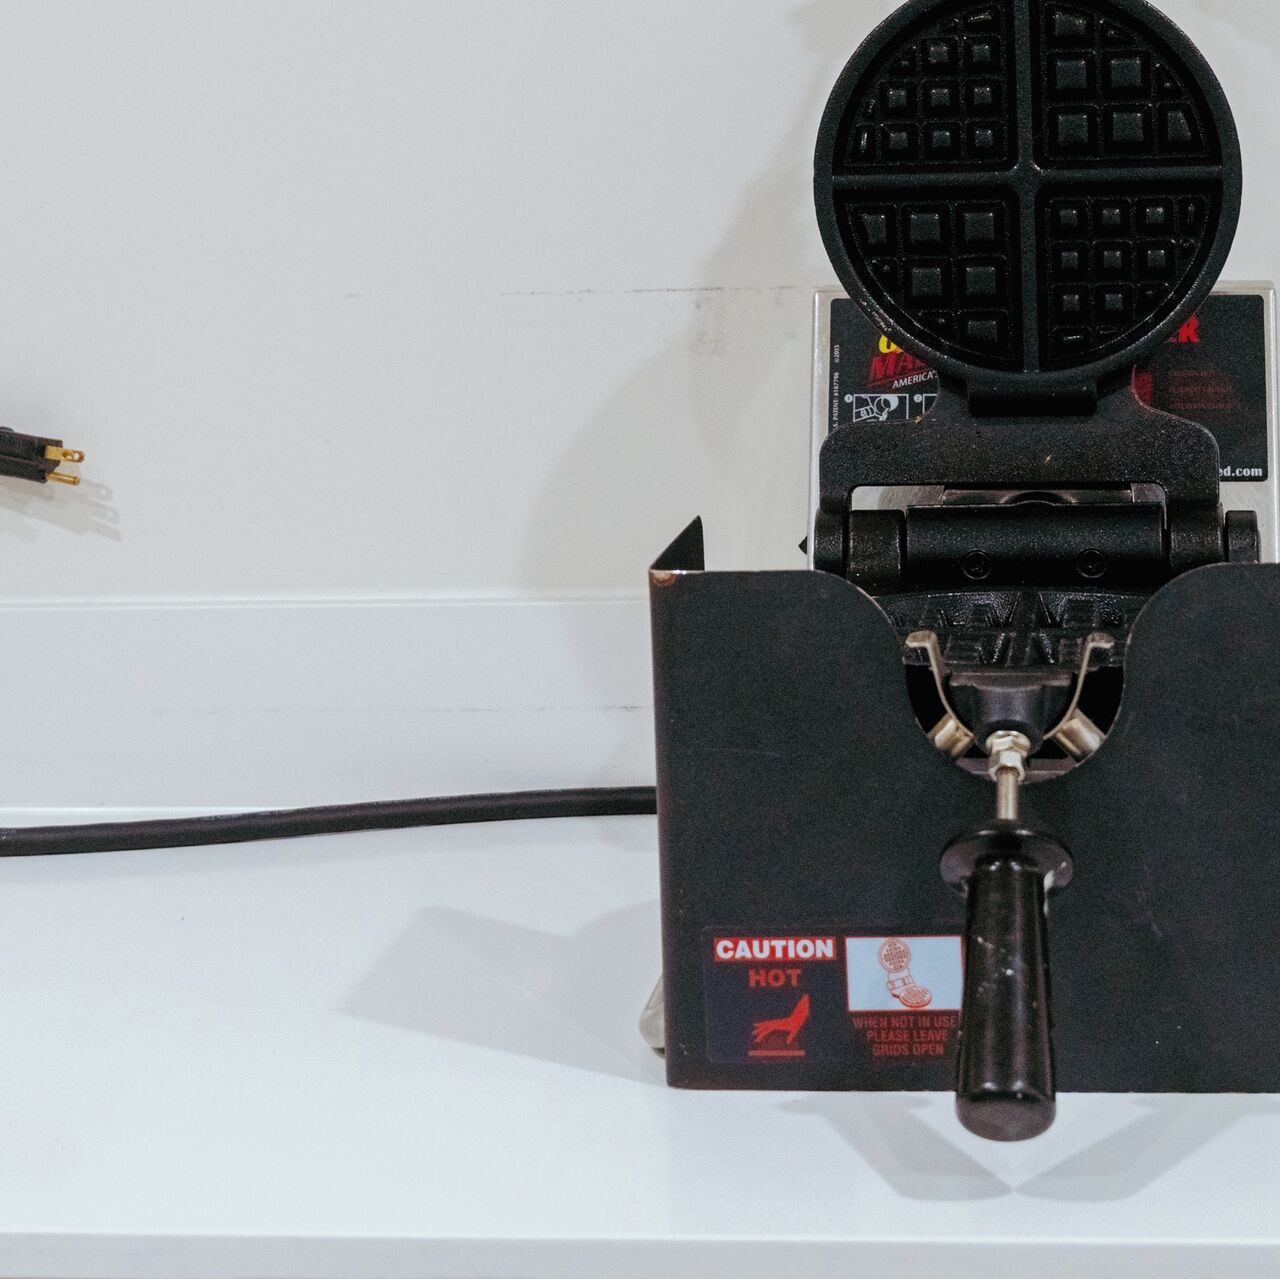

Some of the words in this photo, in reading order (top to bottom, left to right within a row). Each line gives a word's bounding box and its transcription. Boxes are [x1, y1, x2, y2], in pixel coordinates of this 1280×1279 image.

[716, 938, 834, 959] CAUTION
[748, 969, 802, 987] HOT
[852, 1017, 887, 1028] WHEN
[891, 1016, 913, 1027] NOT
[918, 1016, 930, 1028] IN
[934, 1015, 957, 1027] USE
[866, 1030, 910, 1041] PLEASE
[913, 1029, 948, 1041] LEAVE
[872, 1044, 910, 1056] GRIDS
[912, 1044, 944, 1056] OPEN
